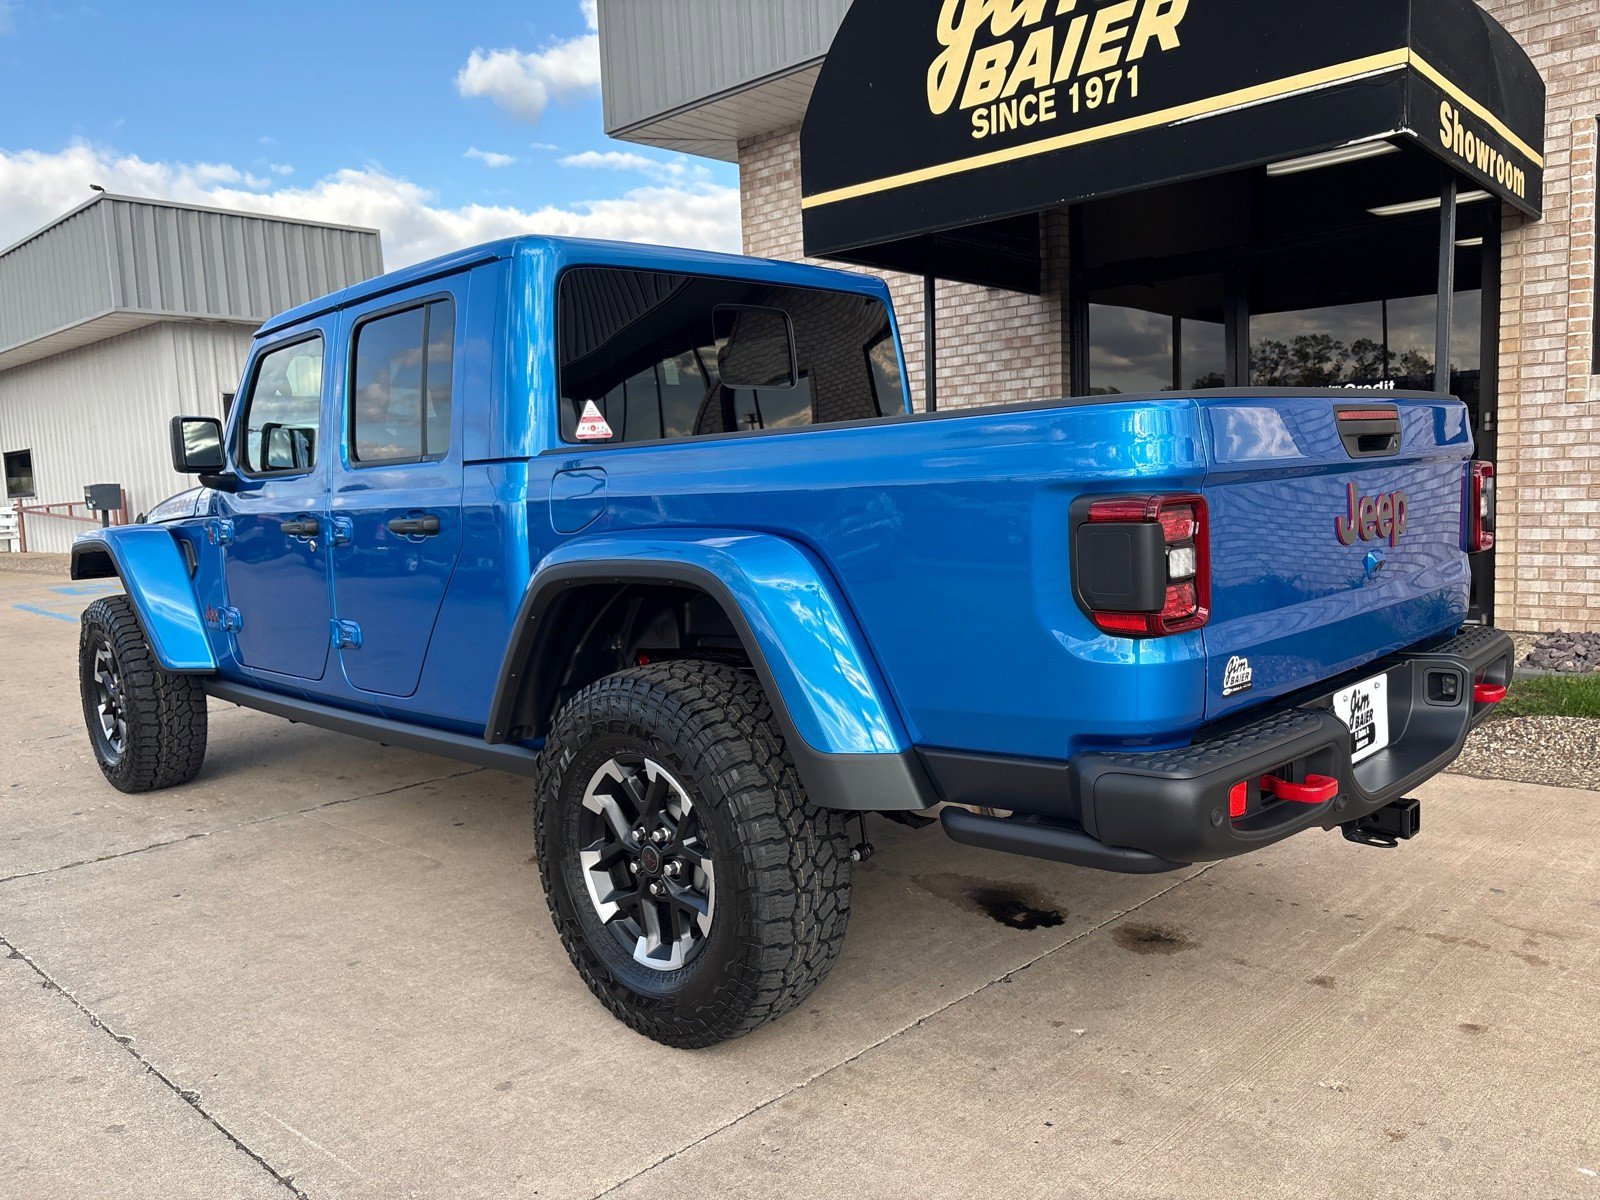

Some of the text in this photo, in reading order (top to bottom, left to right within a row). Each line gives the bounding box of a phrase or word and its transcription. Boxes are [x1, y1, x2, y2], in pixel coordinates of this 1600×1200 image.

[959, 0, 1190, 110] BAIER
[971, 65, 1138, 139] SINCE 1971
[1440, 100, 1525, 199] Showroom
[1334, 481, 1408, 547] Jeep
[1230, 671, 1250, 686] BAIER
[1349, 689, 1370, 731] Jim
[1355, 708, 1374, 729] BAIER
